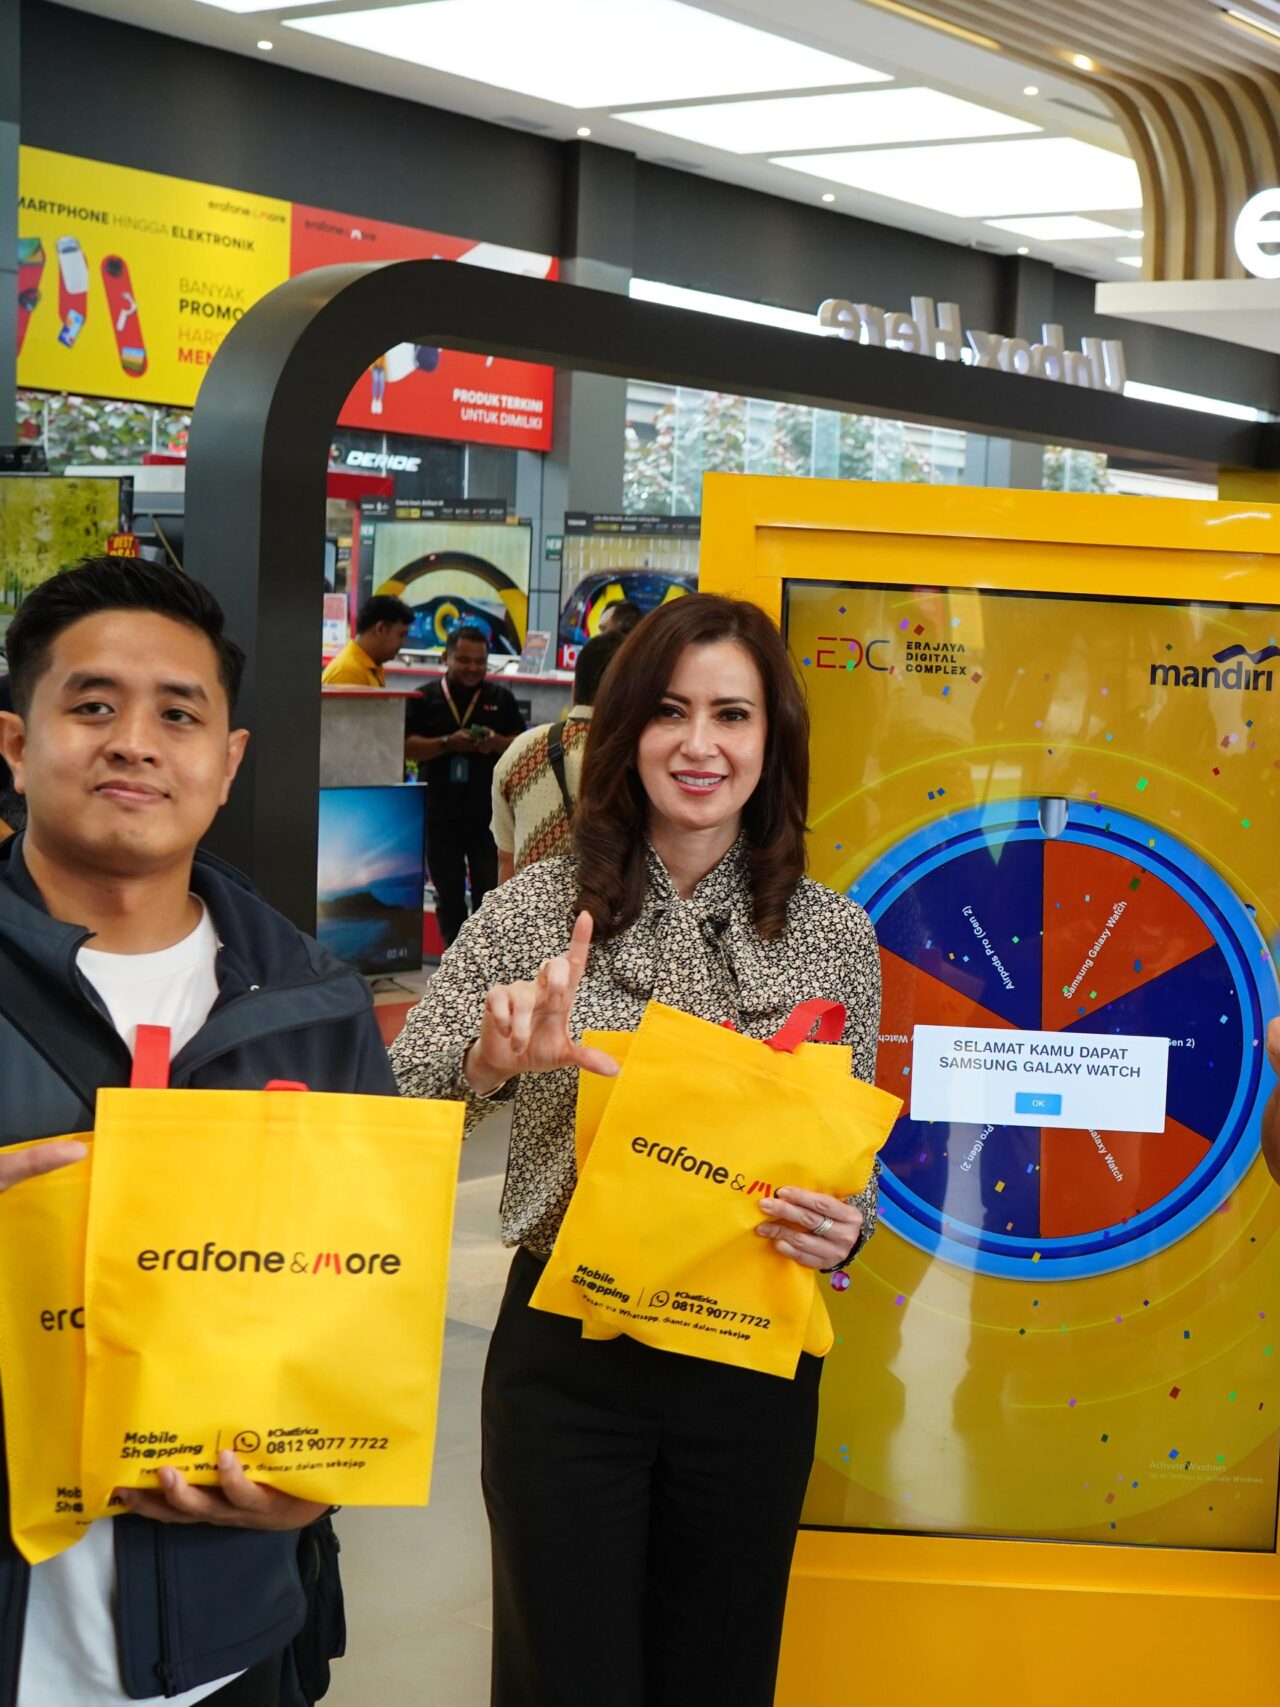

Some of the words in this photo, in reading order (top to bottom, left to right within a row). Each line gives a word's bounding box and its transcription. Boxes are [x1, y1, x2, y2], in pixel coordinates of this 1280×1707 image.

[112, 216, 169, 235] HINGGA
[172, 225, 255, 252] ELEKTRONIK
[179, 277, 245, 302] BANYAK
[453, 388, 500, 407] PRODUK
[501, 394, 543, 413] TERKINI
[461, 406, 499, 424] UNTUK
[501, 412, 543, 430] DIMILIKI
[906, 641, 965, 653] ERAJAYA
[906, 653, 957, 664] DIGITAL
[906, 664, 967, 675] COMPLEX
[1150, 661, 1273, 691] mandiri
[962, 905, 972, 917] 2)
[969, 916, 987, 939] (Gen
[982, 939, 995, 957] Pro
[1063, 958, 1094, 999] Samsung
[1088, 929, 1111, 958] Galaxy
[1106, 900, 1128, 928] Watch
[991, 957, 1015, 990] Airpods
[953, 1039, 1025, 1055] SELAMAT
[1029, 1044, 1074, 1058] KAMU
[1079, 1046, 1128, 1060] DAPAT
[1186, 1038, 1195, 1049] 2)
[939, 1056, 1018, 1072] SAMSUNG
[1023, 1061, 1082, 1075] GALAXY
[1086, 1064, 1141, 1078] WATCH
[1032, 1099, 1045, 1107] OK
[631, 1136, 729, 1184] erafone
[967, 1140, 985, 1161] (Gen
[1104, 1153, 1124, 1182] Watch
[137, 1242, 285, 1273] erafone
[312, 1252, 401, 1275] More
[576, 1264, 615, 1284] Mobile
[672, 1300, 704, 1315] 0812
[706, 1306, 738, 1321] 9077
[739, 1313, 771, 1329] 7722
[663, 1316, 691, 1328] diantar
[693, 1323, 717, 1333] dalam
[719, 1329, 751, 1341] sekejap
[124, 1431, 178, 1445] Mobile
[266, 1440, 303, 1454] 0812
[307, 1438, 345, 1451] 9077
[350, 1438, 389, 1450] 7722
[326, 1459, 365, 1469] sekejap
[1188, 1463, 1227, 1473] Windows
